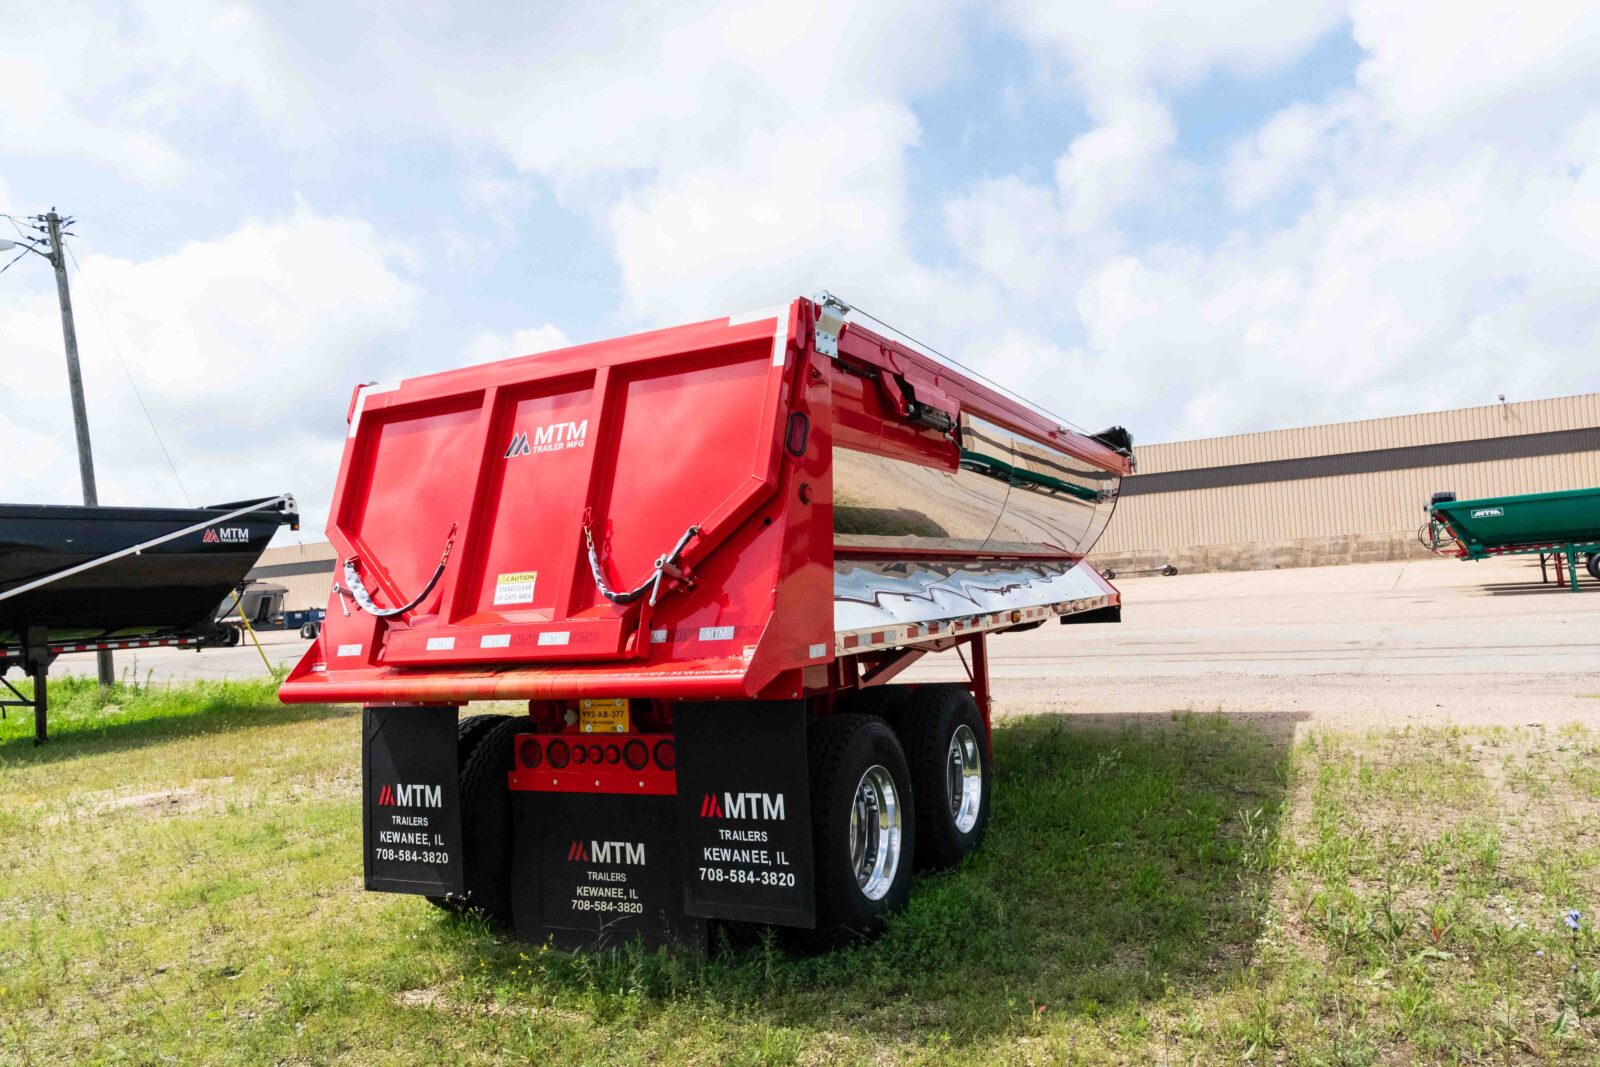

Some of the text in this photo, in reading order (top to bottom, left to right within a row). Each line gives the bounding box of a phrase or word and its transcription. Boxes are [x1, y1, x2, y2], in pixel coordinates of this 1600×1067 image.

[534, 420, 588, 445] MTM
[533, 440, 585, 453] TRAILER MFG
[220, 528, 249, 538] MTM
[506, 574, 535, 583] CAUTION
[707, 629, 727, 639] MTM
[582, 710, 625, 718] 992-AB-377
[397, 784, 442, 808] MTM
[724, 792, 785, 820] MTM
[392, 815, 429, 826] TRAILERS
[380, 831, 445, 847] KEWANEE, IL
[719, 829, 768, 842] TRAILERS
[376, 848, 449, 864] 708-584-3820
[591, 840, 646, 865] MTM
[703, 847, 790, 866] KEWANEE, IL
[587, 871, 627, 882] TRAILERS
[699, 867, 796, 887] 708-584-3820
[576, 886, 639, 900] KEWANEE, IL
[571, 899, 643, 913] 708-584-3820
